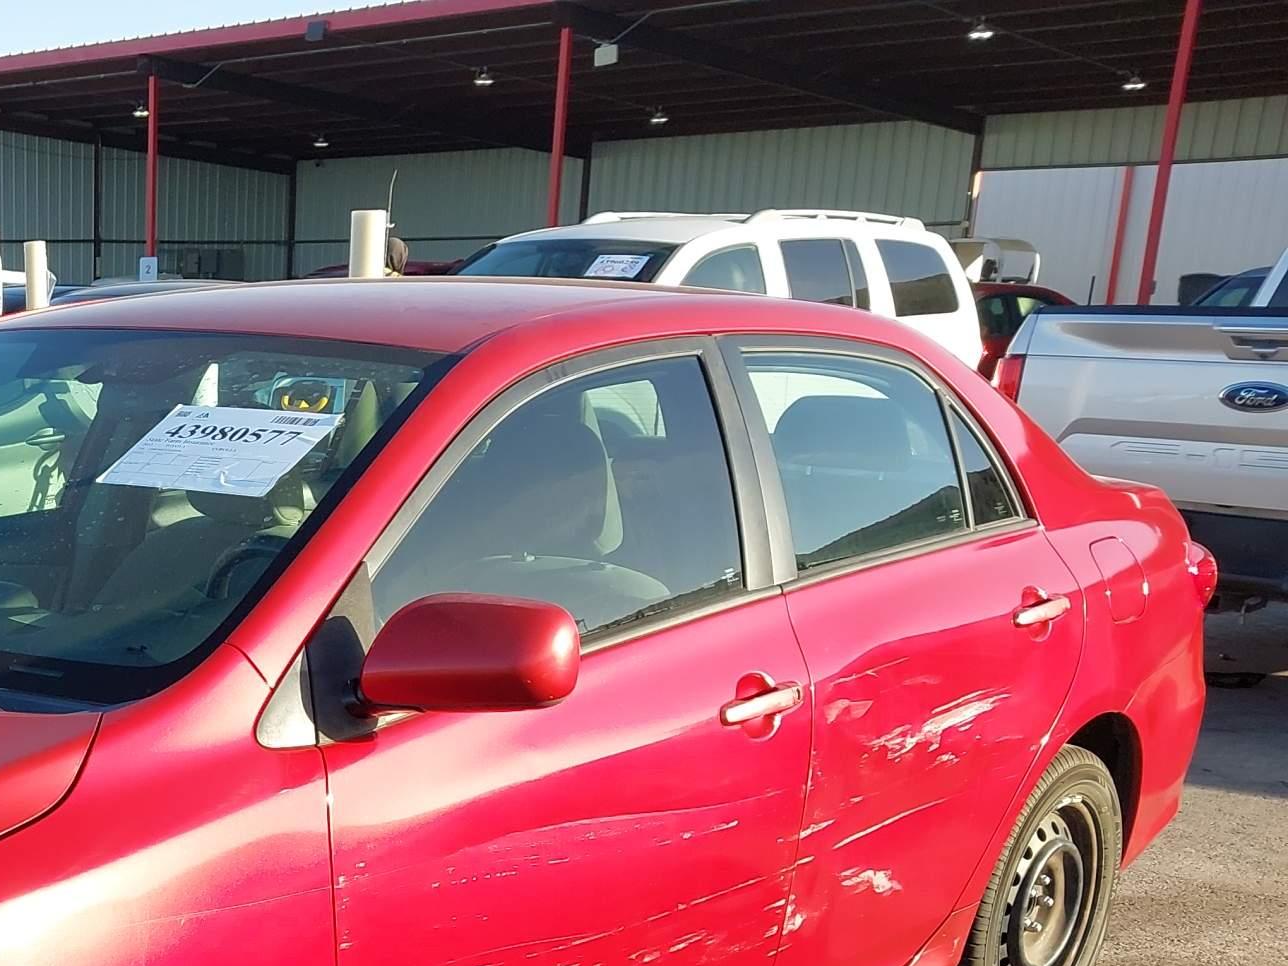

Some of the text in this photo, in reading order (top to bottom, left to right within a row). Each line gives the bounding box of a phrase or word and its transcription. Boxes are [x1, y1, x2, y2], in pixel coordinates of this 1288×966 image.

[145, 264, 152, 275] 2
[1235, 387, 1278, 406] Ford
[165, 423, 303, 446] 43980577
